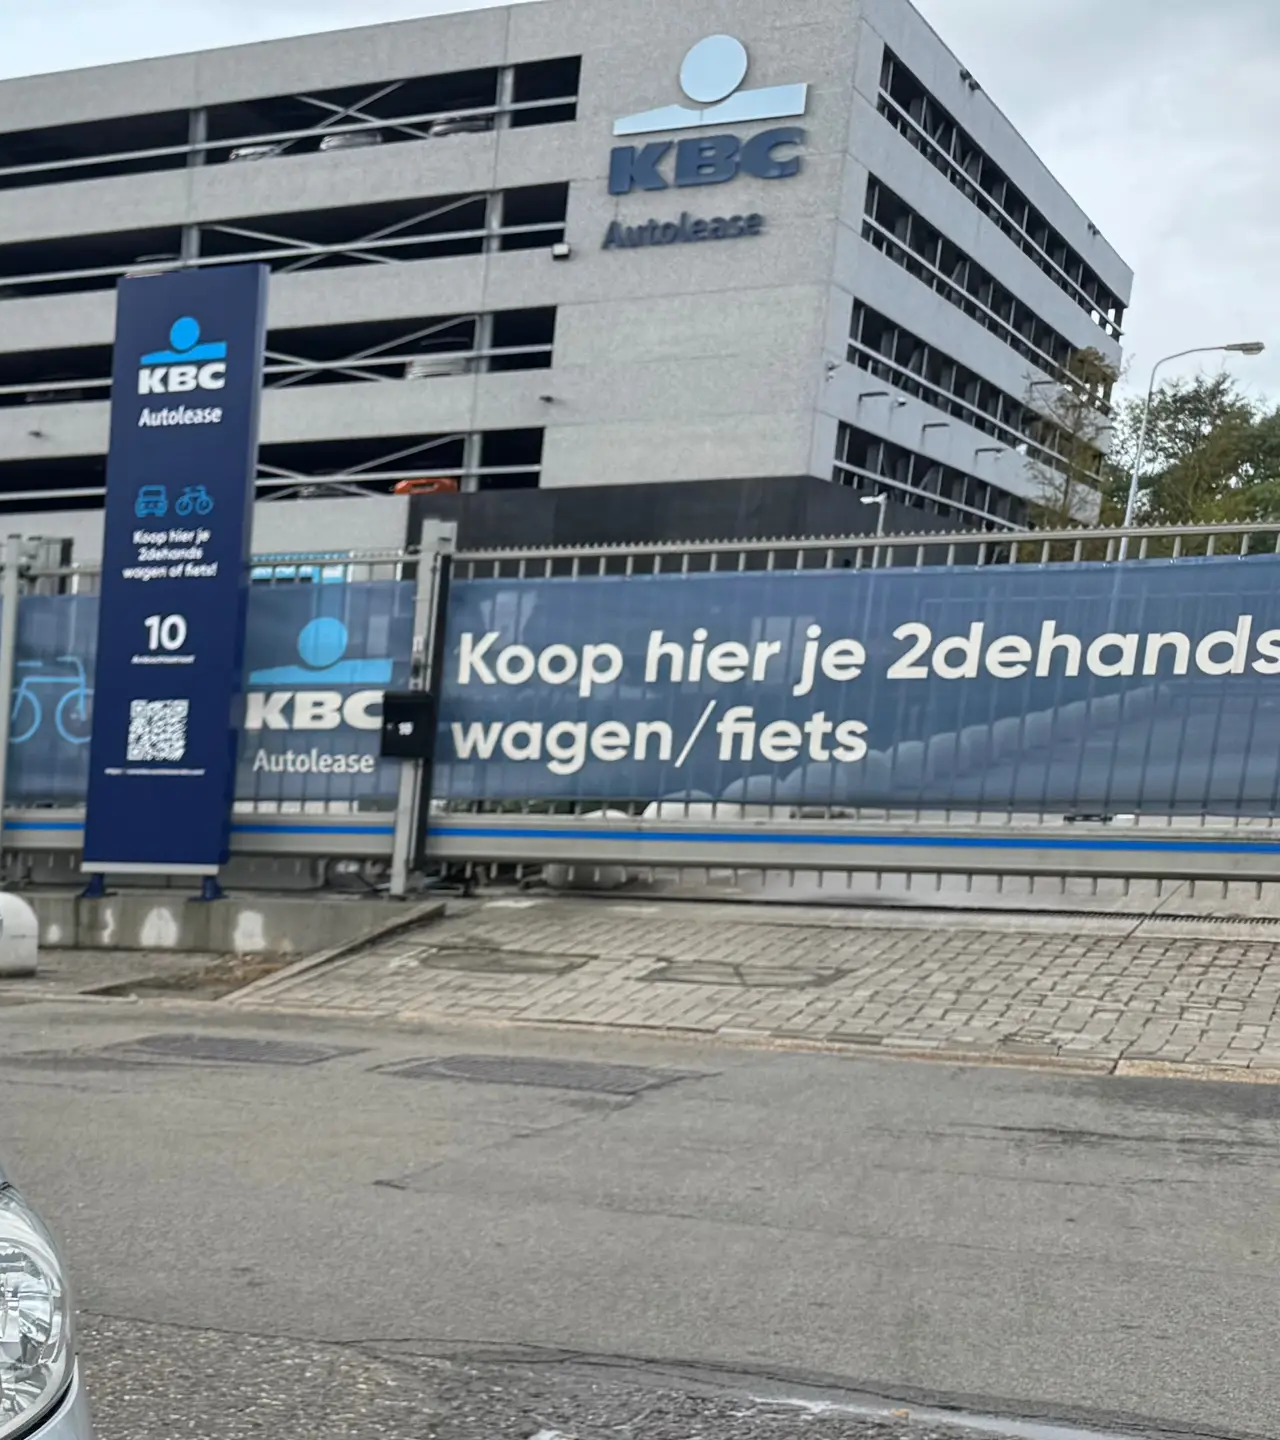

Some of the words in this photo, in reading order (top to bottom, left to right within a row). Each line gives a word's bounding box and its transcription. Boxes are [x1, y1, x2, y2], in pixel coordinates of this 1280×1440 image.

[608, 126, 806, 196] KBC
[601, 211, 765, 251] Autolease
[138, 362, 227, 395] KBC
[138, 404, 223, 427] Autolease
[132, 528, 168, 546] Koop
[168, 527, 195, 544] hier
[195, 526, 211, 545] je
[137, 545, 204, 562] 2dehands
[122, 564, 167, 582] wagen
[168, 562, 185, 578] of
[144, 613, 187, 651] 10
[457, 631, 624, 698] Koop
[644, 627, 782, 683] hier
[792, 624, 867, 697] je
[886, 614, 1280, 680] 2dehands
[244, 689, 385, 731] KBC
[451, 699, 869, 776] wagen/fiets
[253, 748, 375, 773] Autolease
